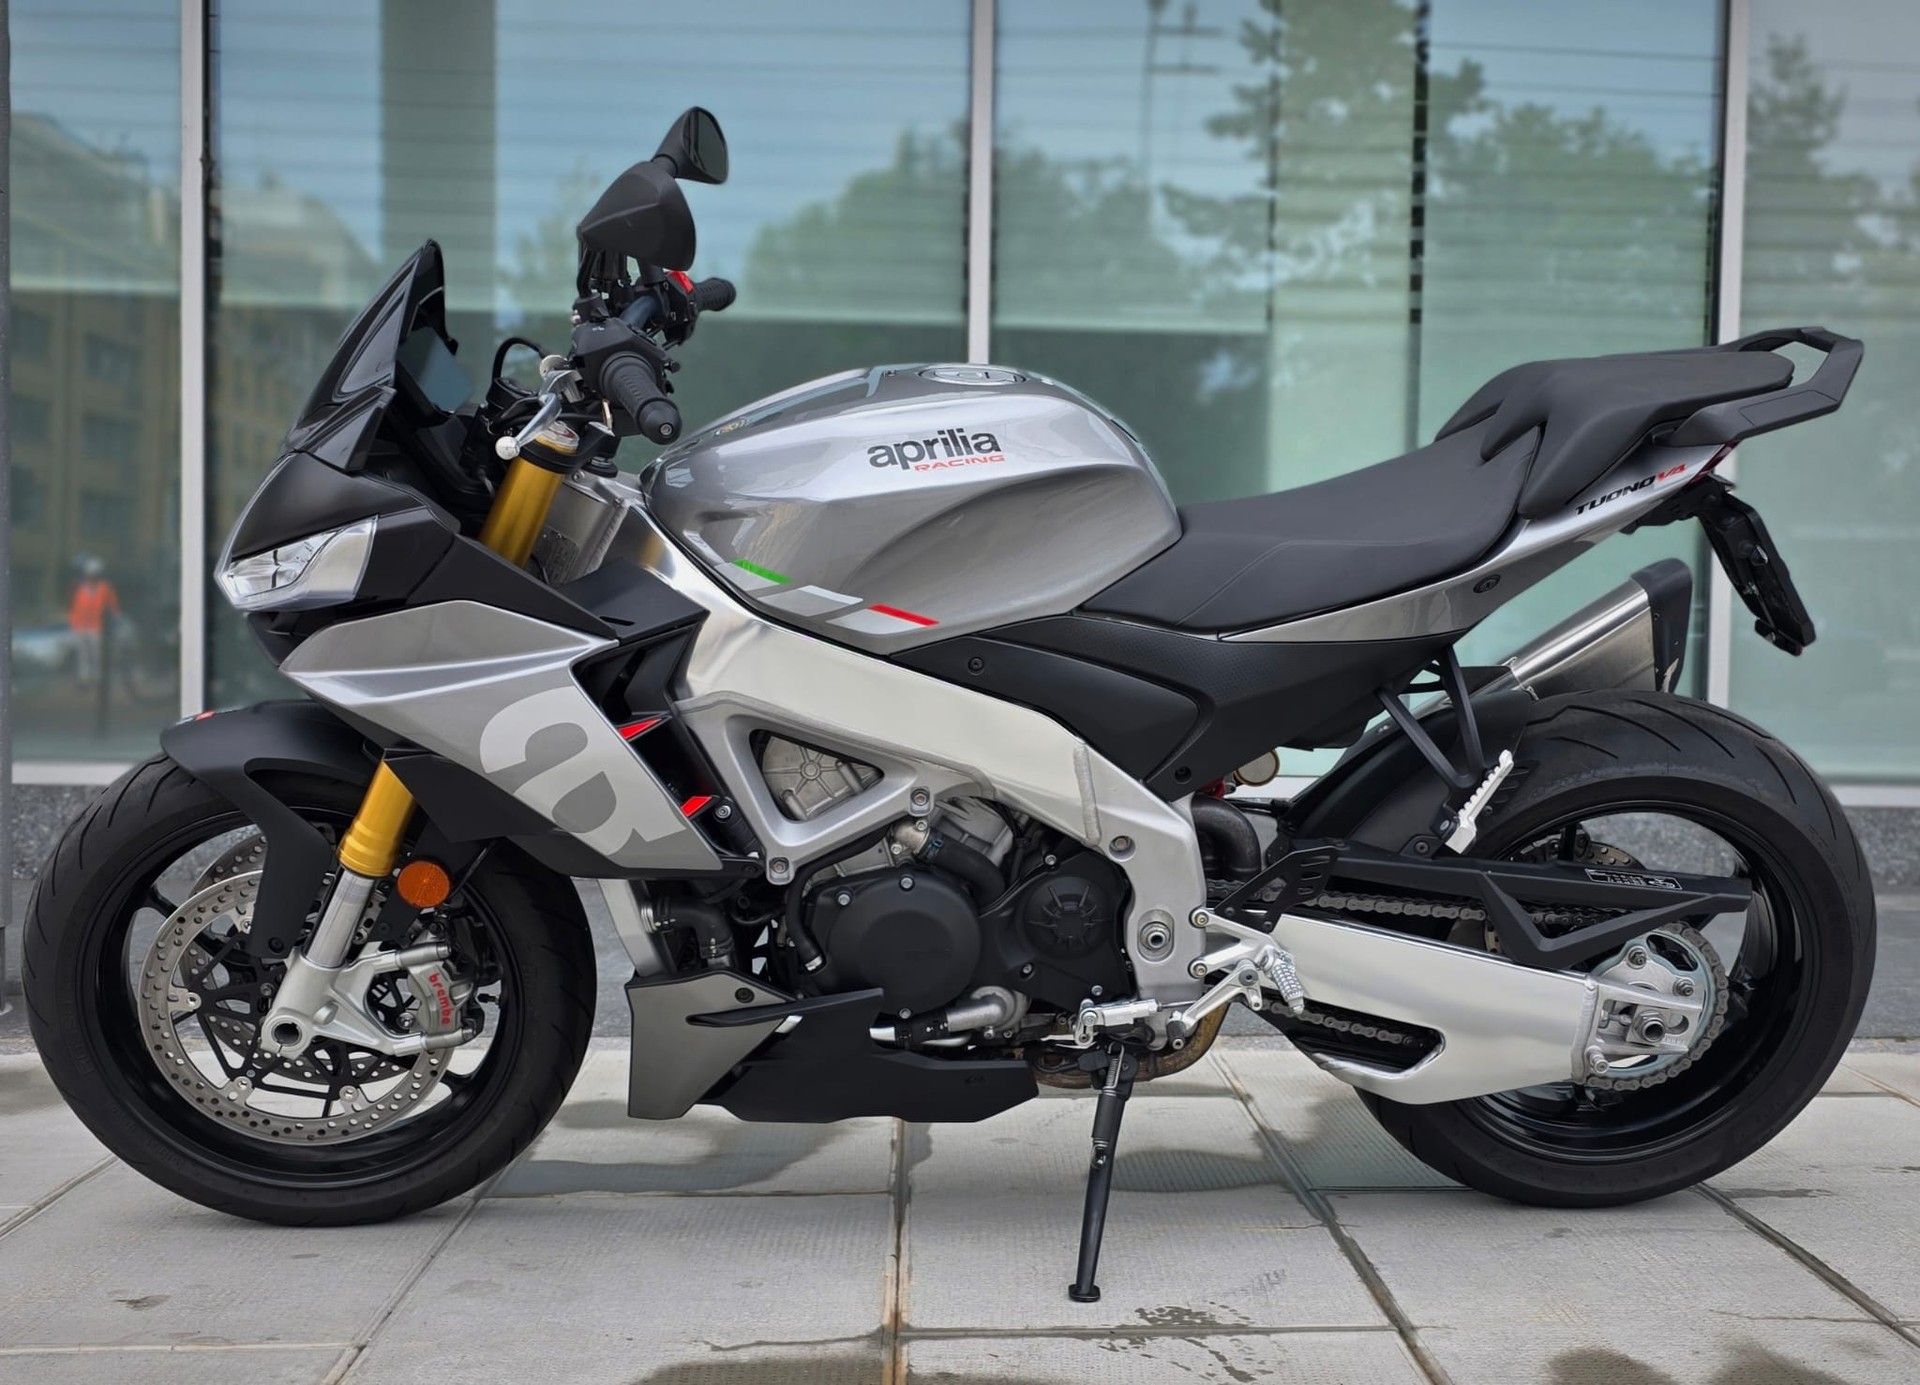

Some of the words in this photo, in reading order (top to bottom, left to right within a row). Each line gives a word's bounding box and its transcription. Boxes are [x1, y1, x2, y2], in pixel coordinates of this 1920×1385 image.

[867, 428, 1001, 470] aprilia
[914, 454, 1006, 471] RACING
[1575, 475, 1656, 515] TUONO
[1657, 463, 1688, 481] V4
[428, 971, 454, 1027] brembo
